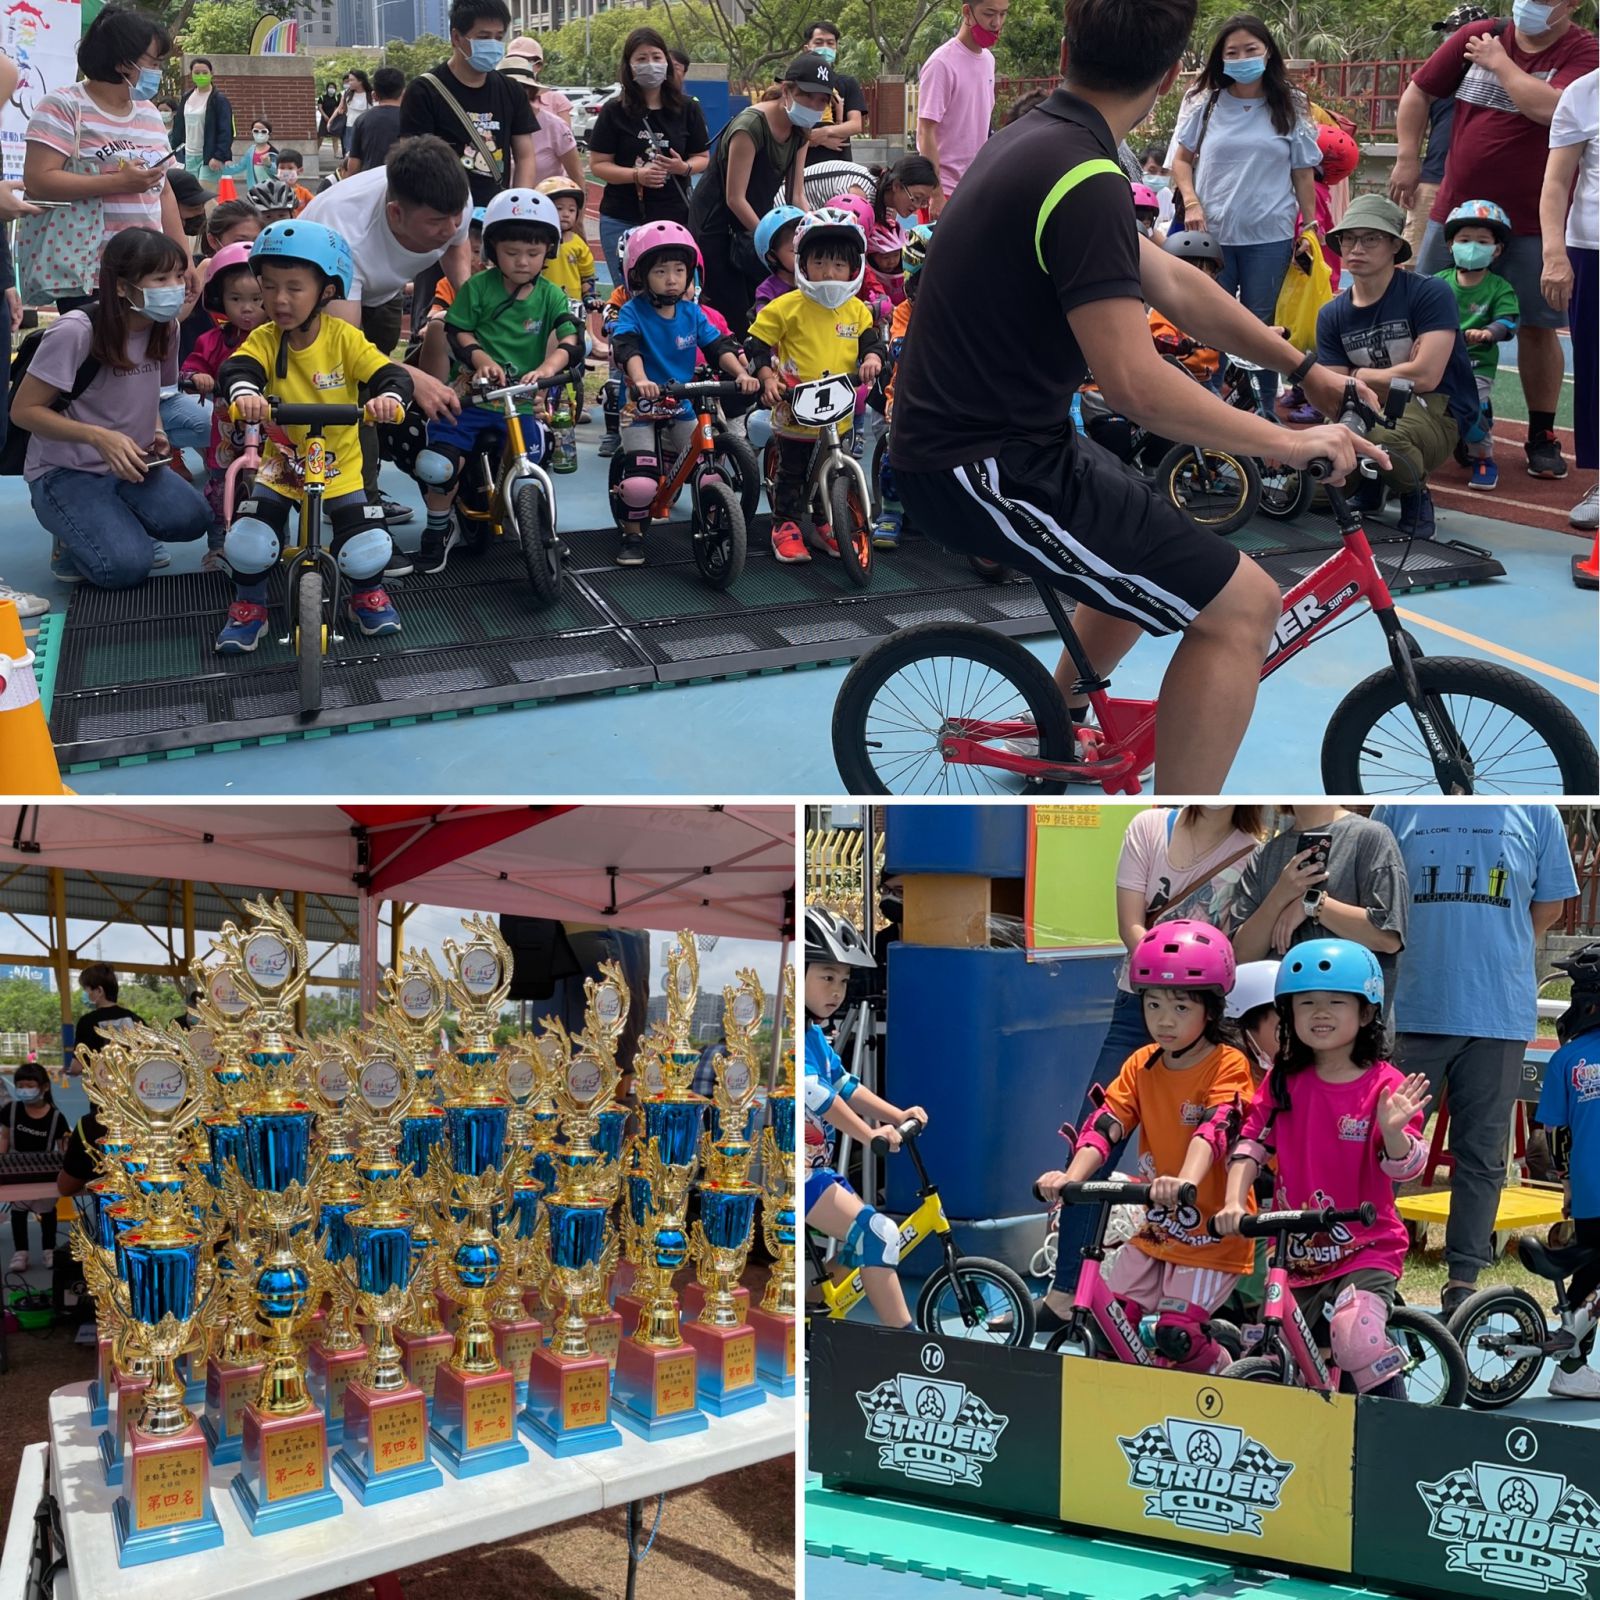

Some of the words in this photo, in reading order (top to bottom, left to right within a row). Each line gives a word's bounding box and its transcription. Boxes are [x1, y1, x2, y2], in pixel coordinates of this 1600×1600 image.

[816, 65, 829, 82] NY
[95, 139, 136, 161] PEANUTS
[814, 387, 832, 409] 1
[816, 405, 832, 413] PRO
[1327, 586, 1354, 611] SUPER
[1415, 827, 1451, 836] WELCOME
[1081, 1181, 1125, 1193] STRIDER
[1256, 1210, 1304, 1224] STRIDER
[1305, 1245, 1341, 1262] PUSH
[924, 1349, 943, 1367] 10
[728, 1362, 752, 1379] 第四名
[662, 1385, 690, 1402] 第一名
[1204, 1394, 1216, 1411] 9
[570, 1399, 601, 1417] 第四名
[473, 1415, 506, 1435] 第一名
[871, 1412, 994, 1455] STRIDER
[381, 1436, 418, 1458] 第四名
[1514, 1435, 1529, 1454] 4
[903, 1446, 957, 1465] CUP
[274, 1461, 316, 1484] 第一名
[1134, 1458, 1278, 1503] STRIDER
[146, 1488, 195, 1513] 第四名
[1172, 1494, 1235, 1514] CUP
[1437, 1506, 1600, 1559] STRIDER
[1479, 1546, 1553, 1568] CUP
